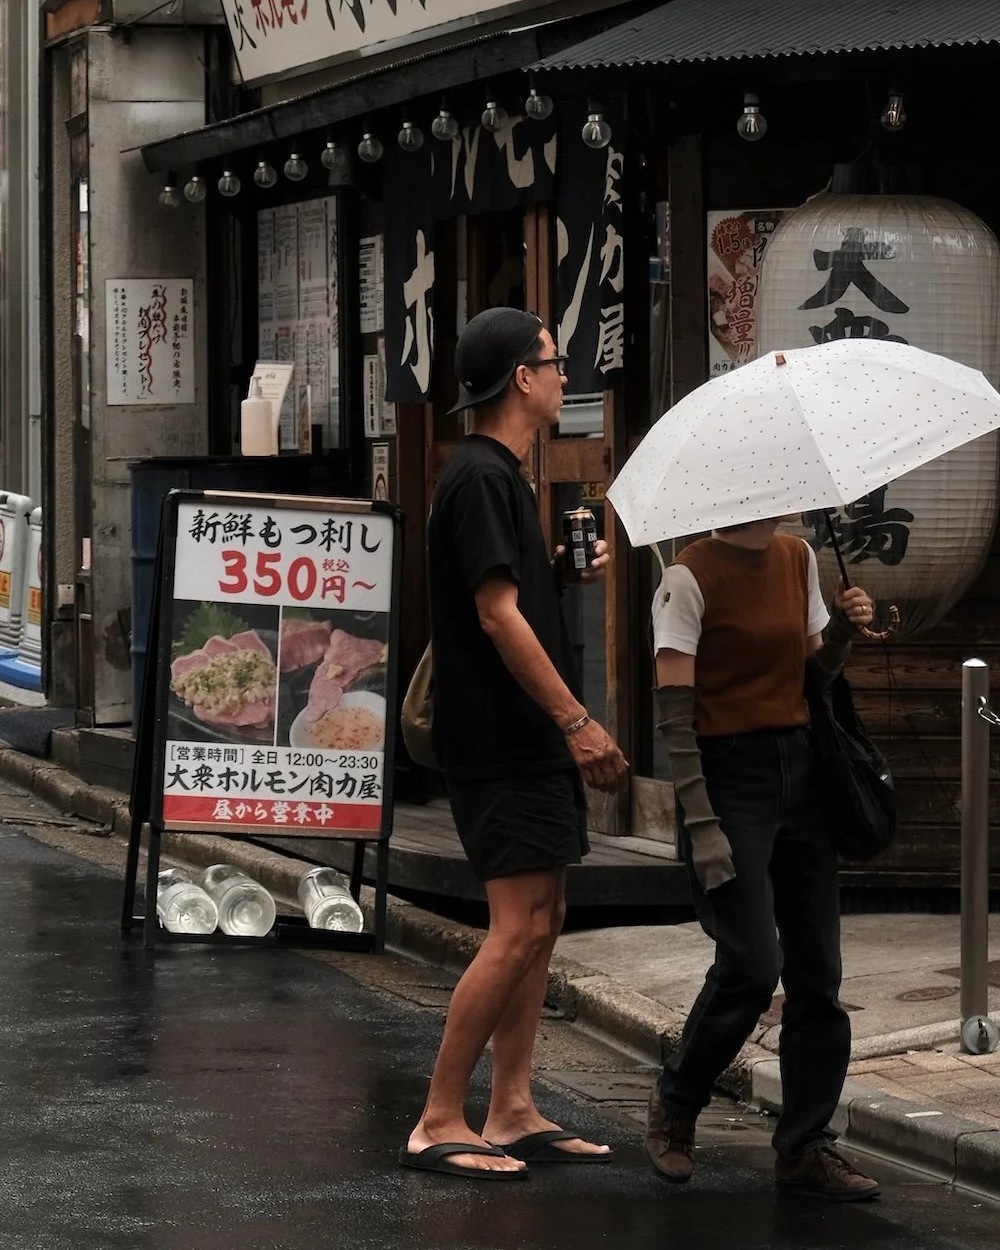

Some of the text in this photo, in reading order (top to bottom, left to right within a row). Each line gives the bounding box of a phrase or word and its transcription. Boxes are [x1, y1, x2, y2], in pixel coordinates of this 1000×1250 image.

[188, 510, 382, 554] 新鮮もつ刺し
[322, 558, 351, 573] 税込
[252, 750, 278, 765] 全日
[165, 764, 382, 800] 大衆ホルモン肉力屋
[212, 799, 334, 826] 昼から営業中
